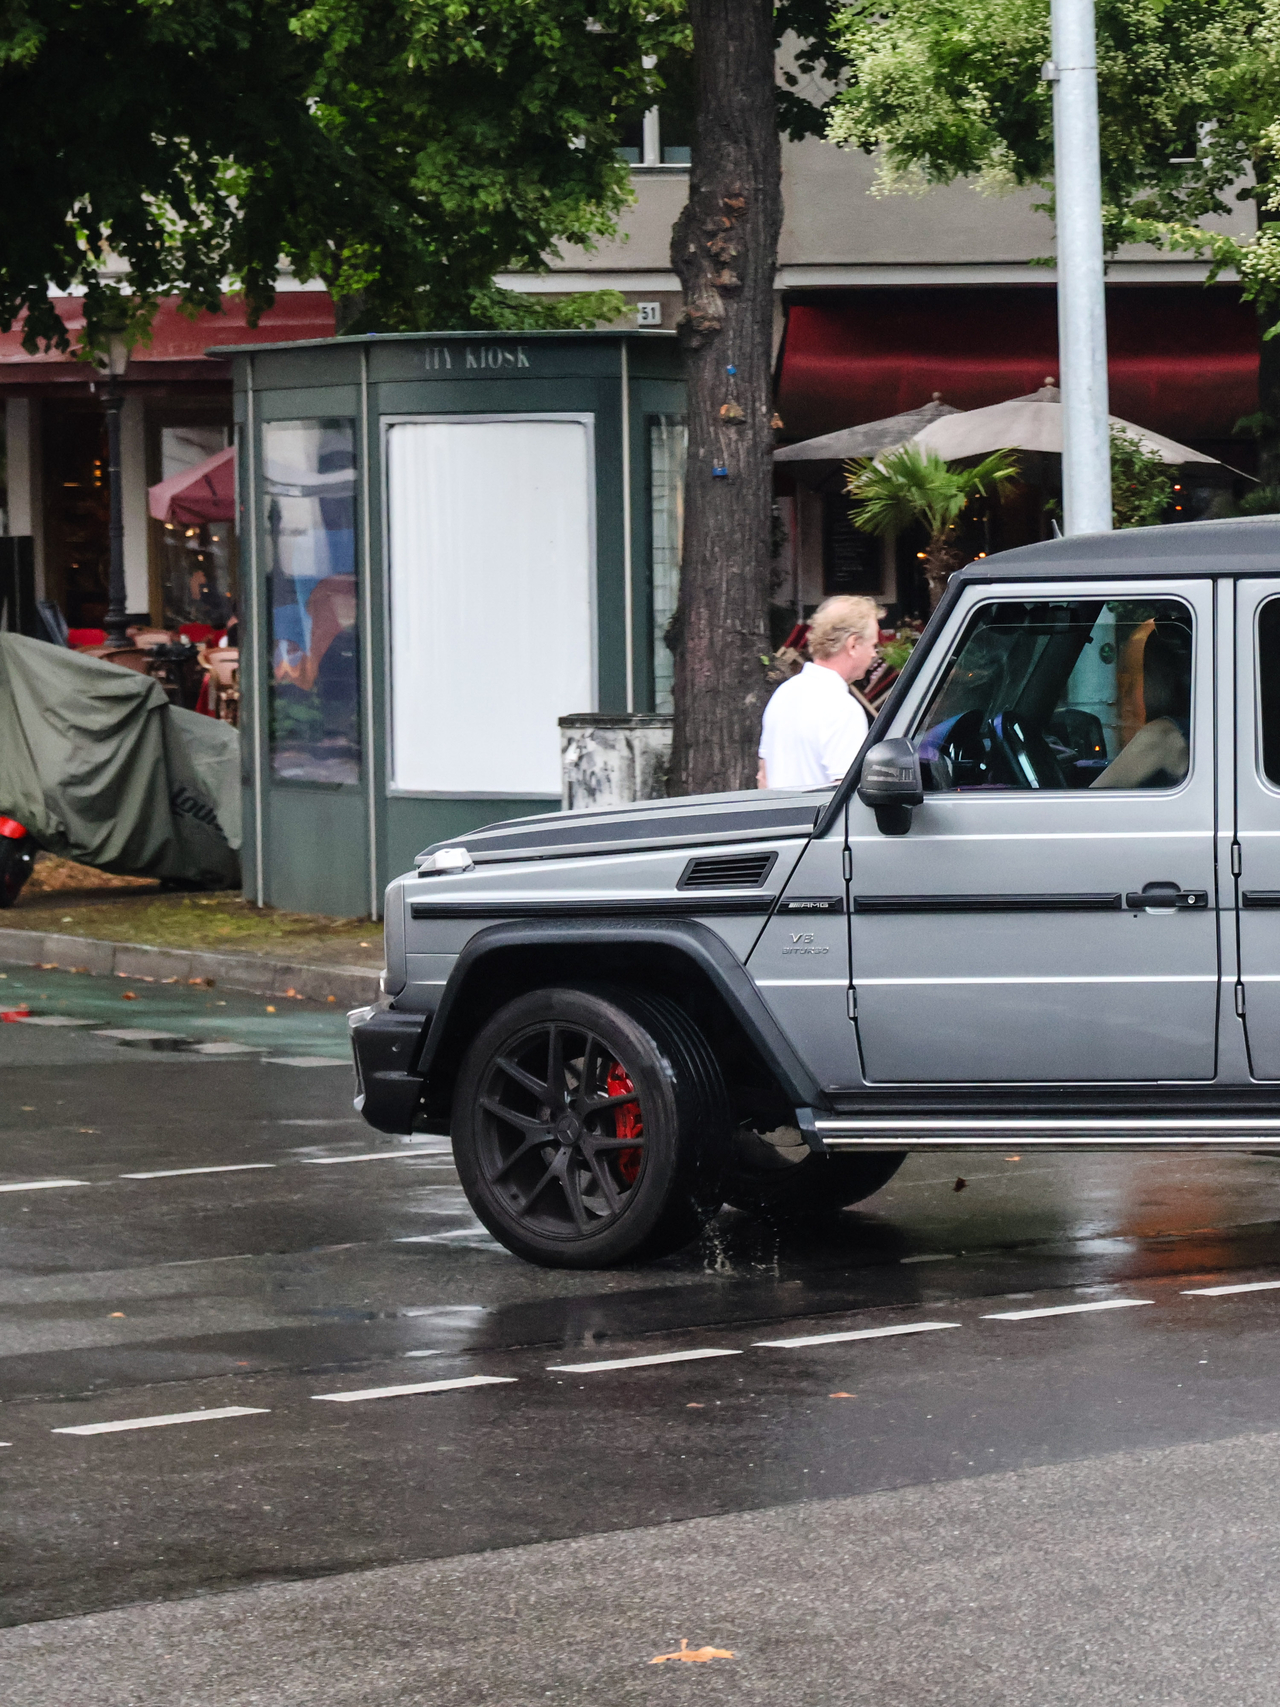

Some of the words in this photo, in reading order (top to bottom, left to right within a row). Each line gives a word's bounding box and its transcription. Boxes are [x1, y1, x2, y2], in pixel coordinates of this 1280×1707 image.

[410, 346, 452, 370] ITY
[465, 345, 530, 369] KIOSK
[798, 901, 829, 909] AMG
[789, 932, 814, 944] V8
